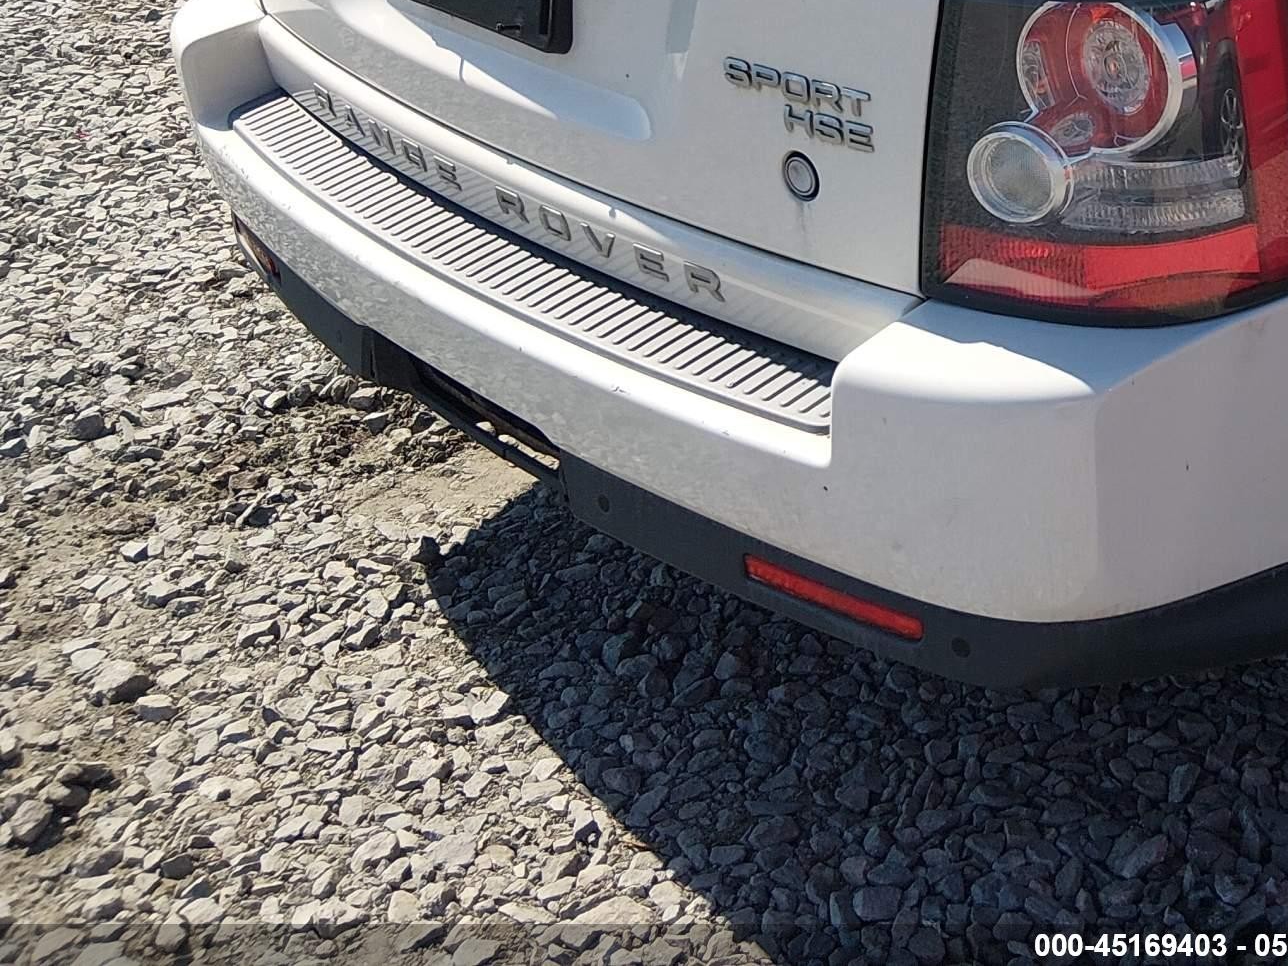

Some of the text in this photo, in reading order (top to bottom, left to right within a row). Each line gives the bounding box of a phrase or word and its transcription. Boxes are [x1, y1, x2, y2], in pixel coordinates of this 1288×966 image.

[723, 55, 873, 119] SPORT
[783, 103, 876, 154] HSE
[311, 82, 727, 303] RANGE ROVER
